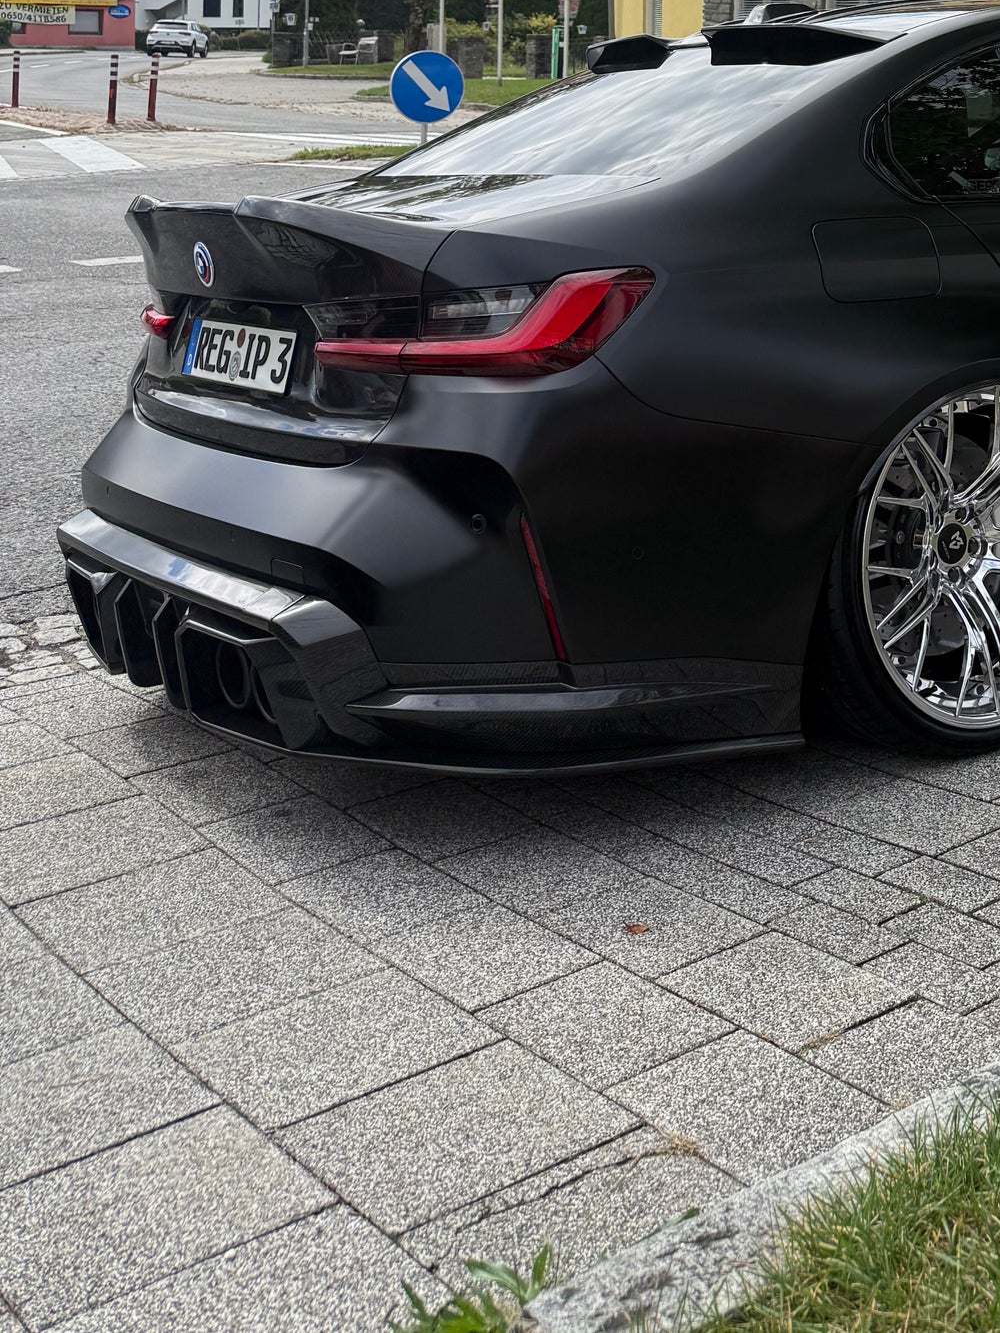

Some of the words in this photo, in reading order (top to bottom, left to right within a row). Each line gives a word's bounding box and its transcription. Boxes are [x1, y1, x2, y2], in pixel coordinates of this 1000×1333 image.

[15, 2, 69, 14] VERMIETEN
[193, 327, 235, 374] REG
[239, 333, 271, 380] IP
[270, 337, 293, 384] 3
